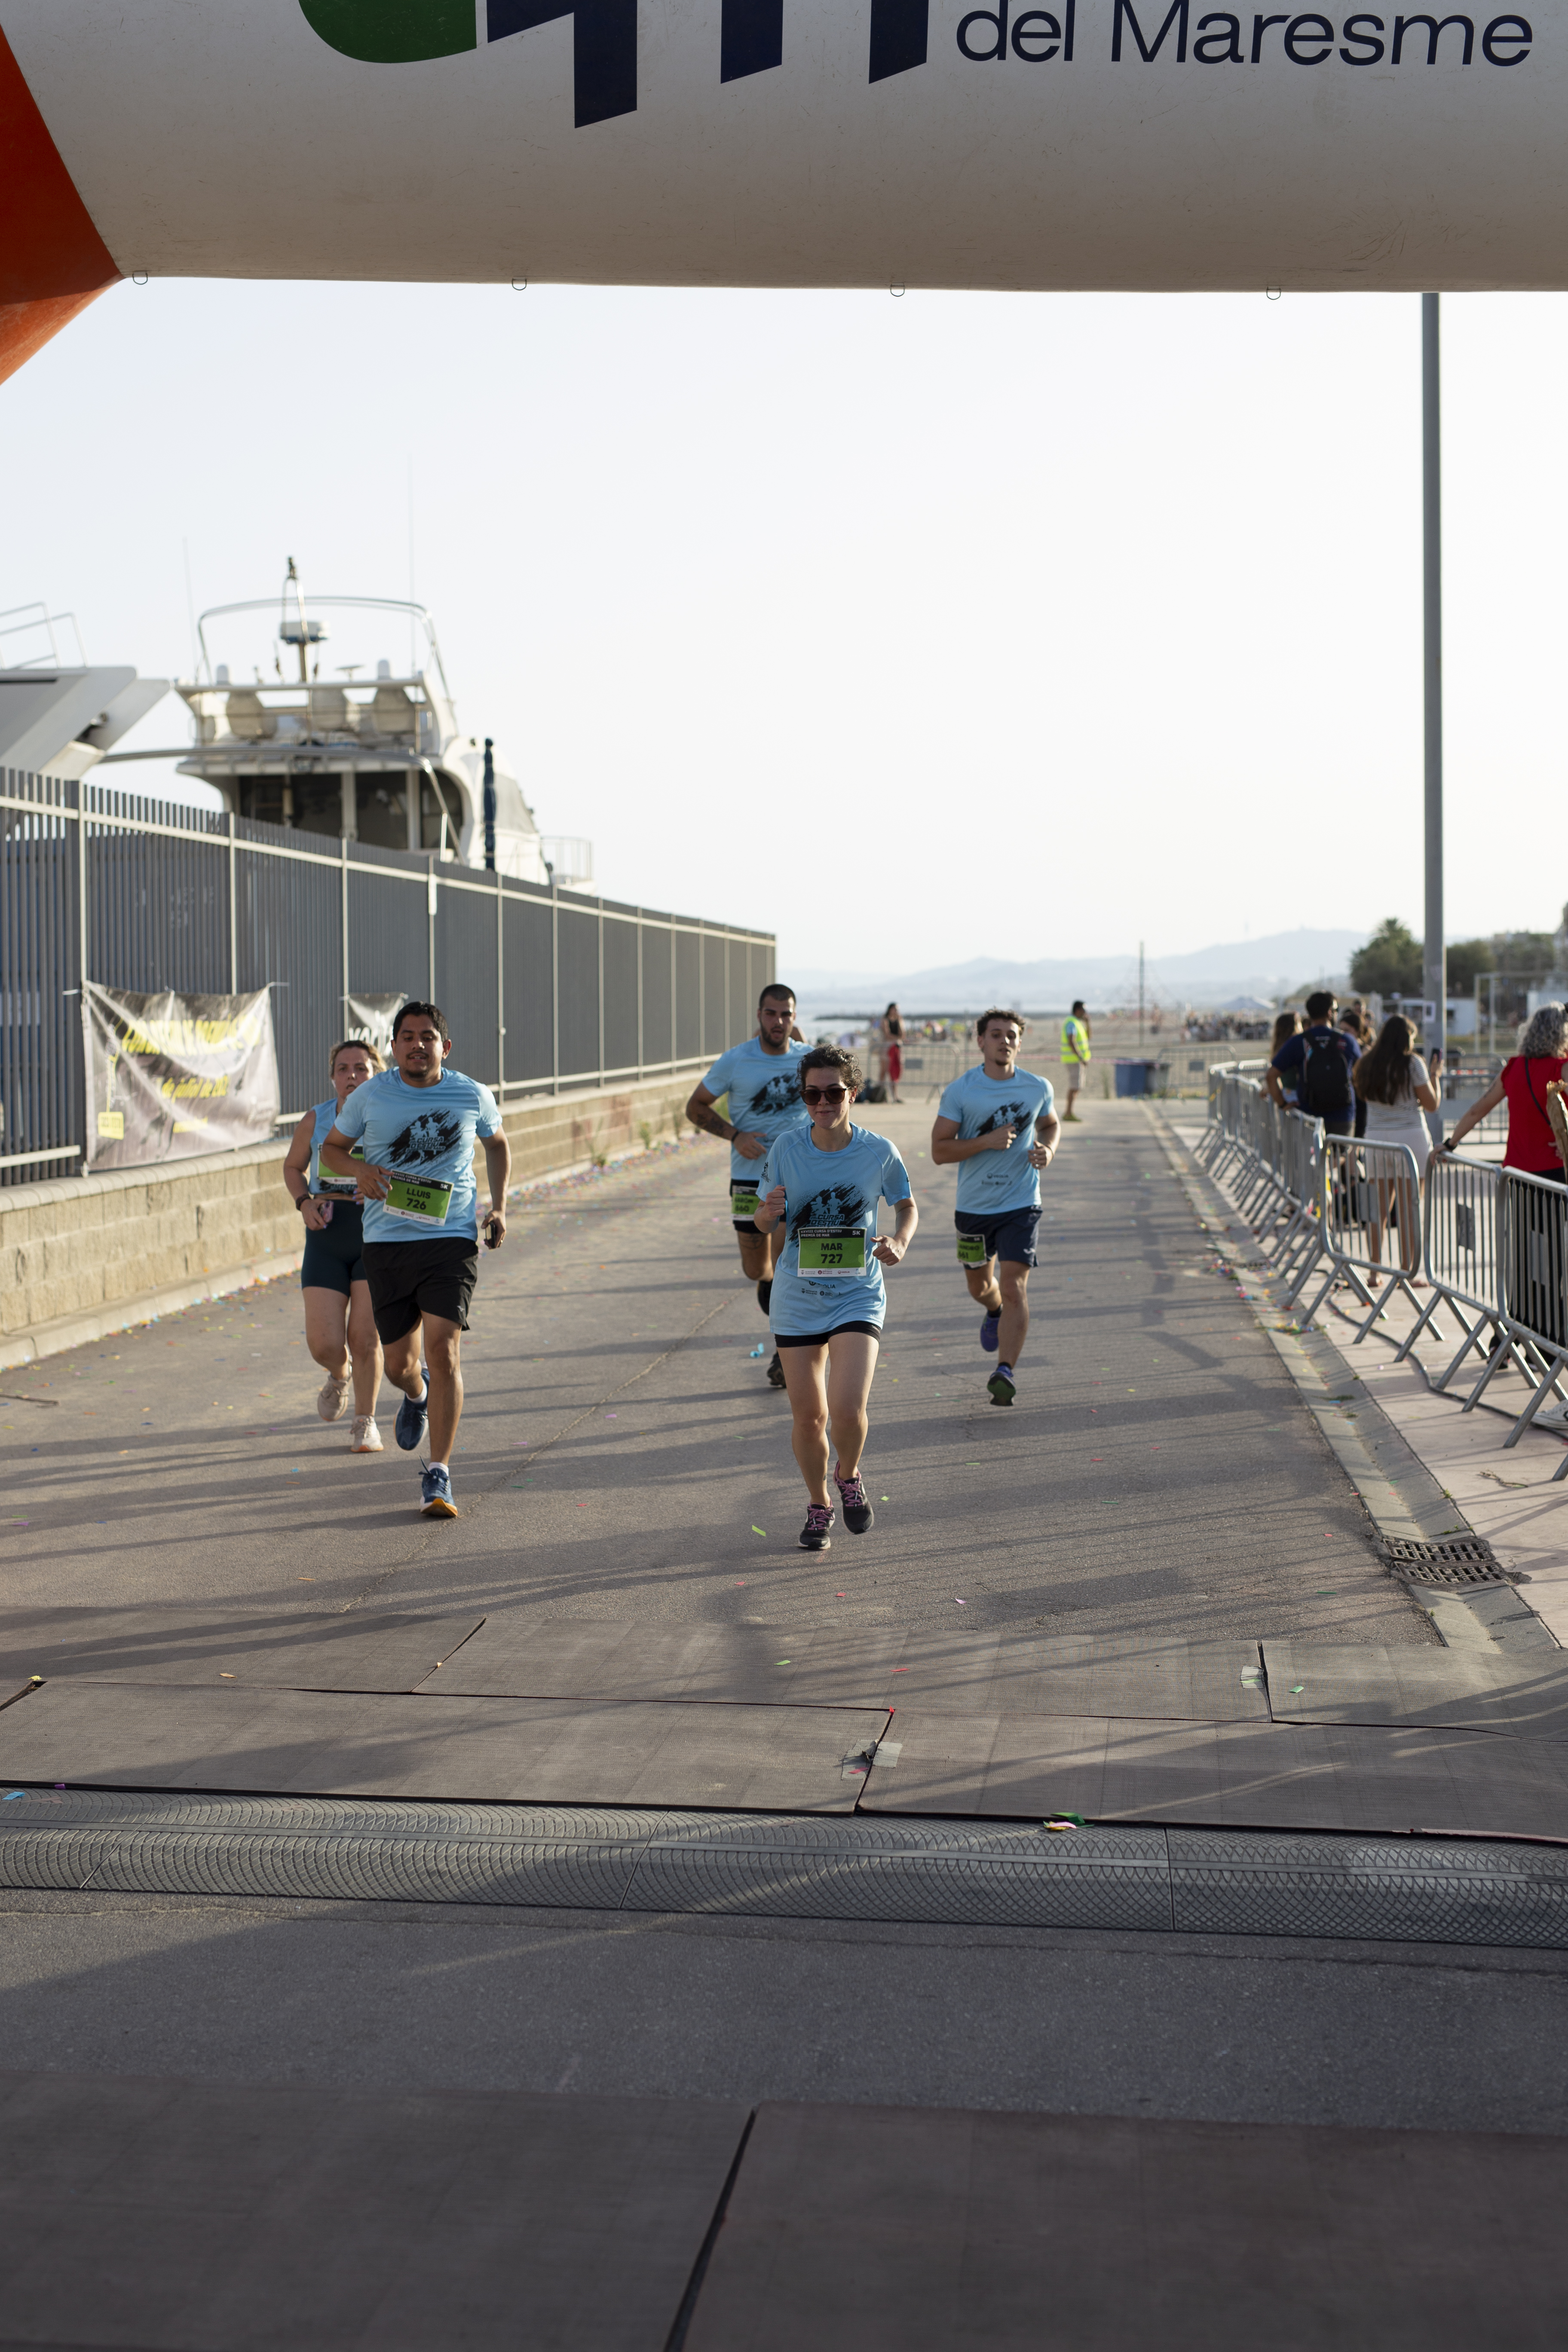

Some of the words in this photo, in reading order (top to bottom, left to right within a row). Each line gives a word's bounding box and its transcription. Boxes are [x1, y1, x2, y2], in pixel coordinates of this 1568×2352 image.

[956, 0, 1075, 62] del
[1111, 0, 1533, 66] Maresme
[406, 1188, 431, 1199] LLUIS
[406, 1198, 426, 1210] 726
[821, 1243, 843, 1251] MAR
[821, 1253, 843, 1264] 727
